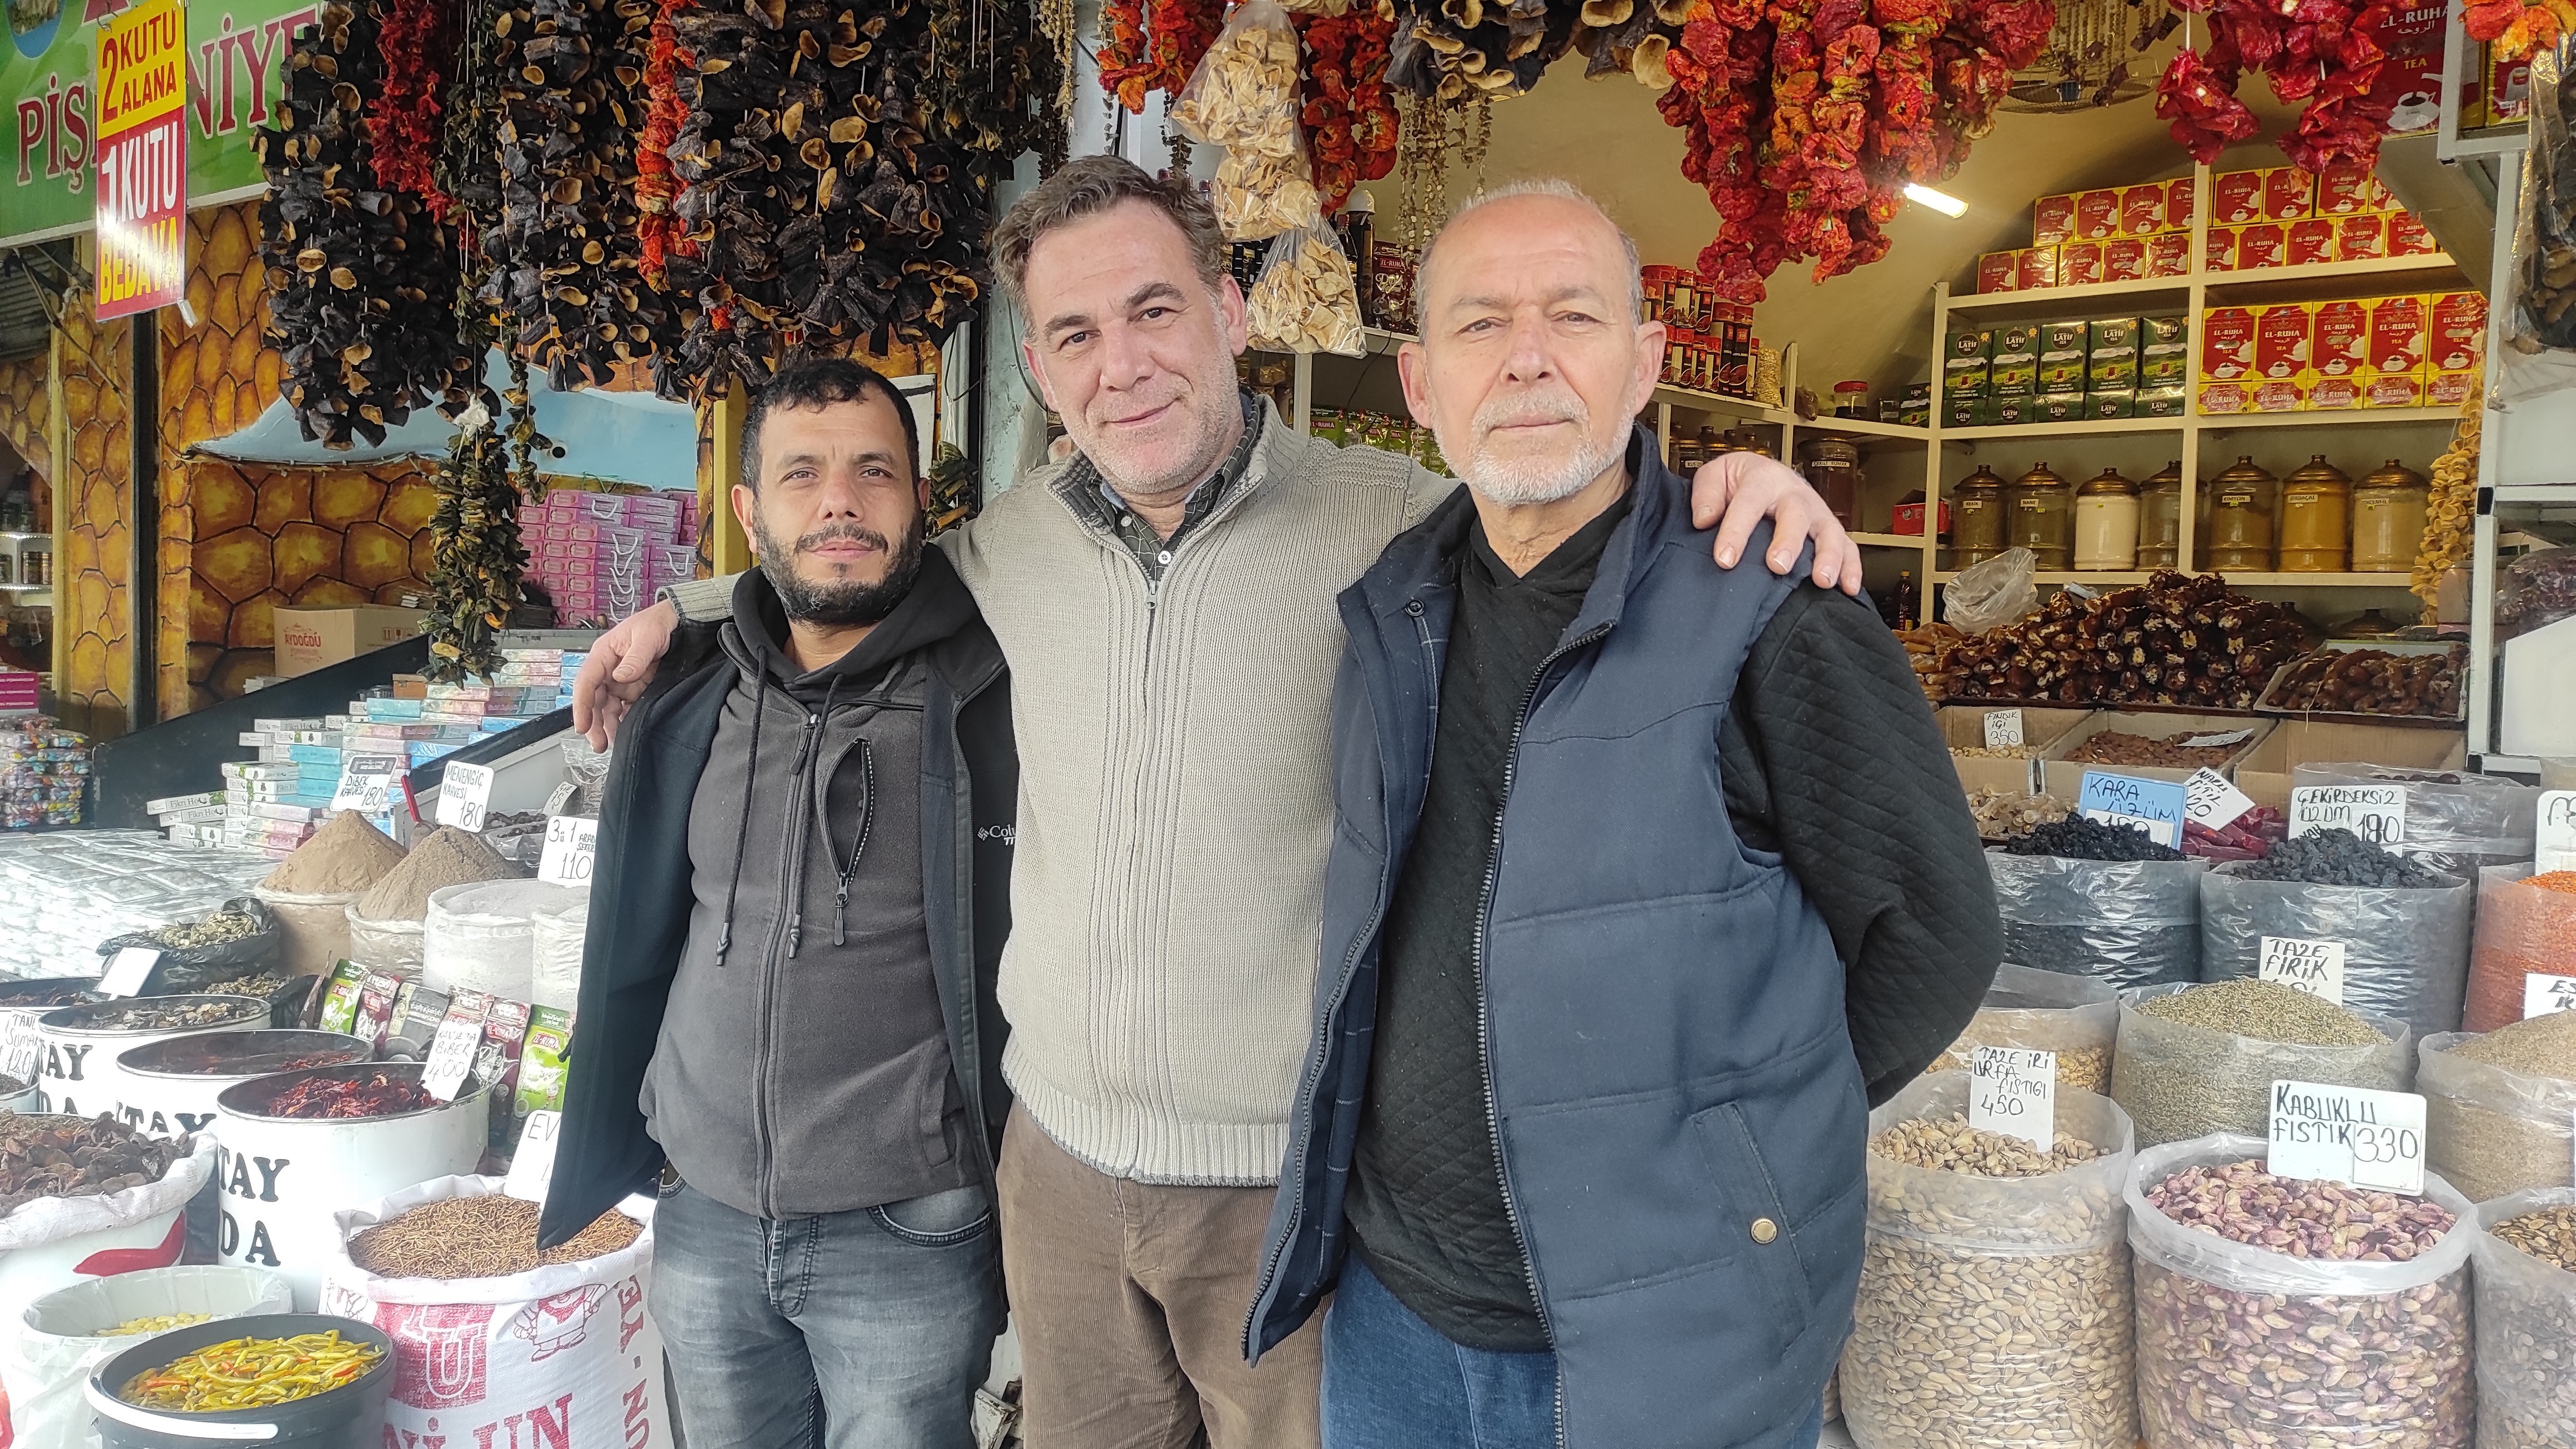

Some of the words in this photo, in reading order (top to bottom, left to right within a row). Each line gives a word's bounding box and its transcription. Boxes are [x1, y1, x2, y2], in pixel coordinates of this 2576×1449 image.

[120, 8, 177, 71] KUTU
[2404, 58, 2428, 69] TEA
[120, 61, 177, 115] ALANA
[102, 144, 117, 225] 1
[122, 121, 178, 222] KUTU
[99, 217, 180, 305] BEDAVA
[1987, 711, 2017, 721] FINDIK
[1989, 729, 2019, 746] 350
[445, 764, 484, 791] MENENGİÇ
[2089, 776, 2140, 802] KARA
[170, 797, 187, 808] Fikri
[362, 787, 383, 806] 180
[459, 800, 484, 828] 180
[558, 852, 592, 879] 110
[1981, 1094, 2024, 1116] 450
[2276, 1083, 2377, 1125] KABUKLU
[2273, 1118, 2354, 1150] FISTIK
[2354, 1128, 2418, 1163] 330
